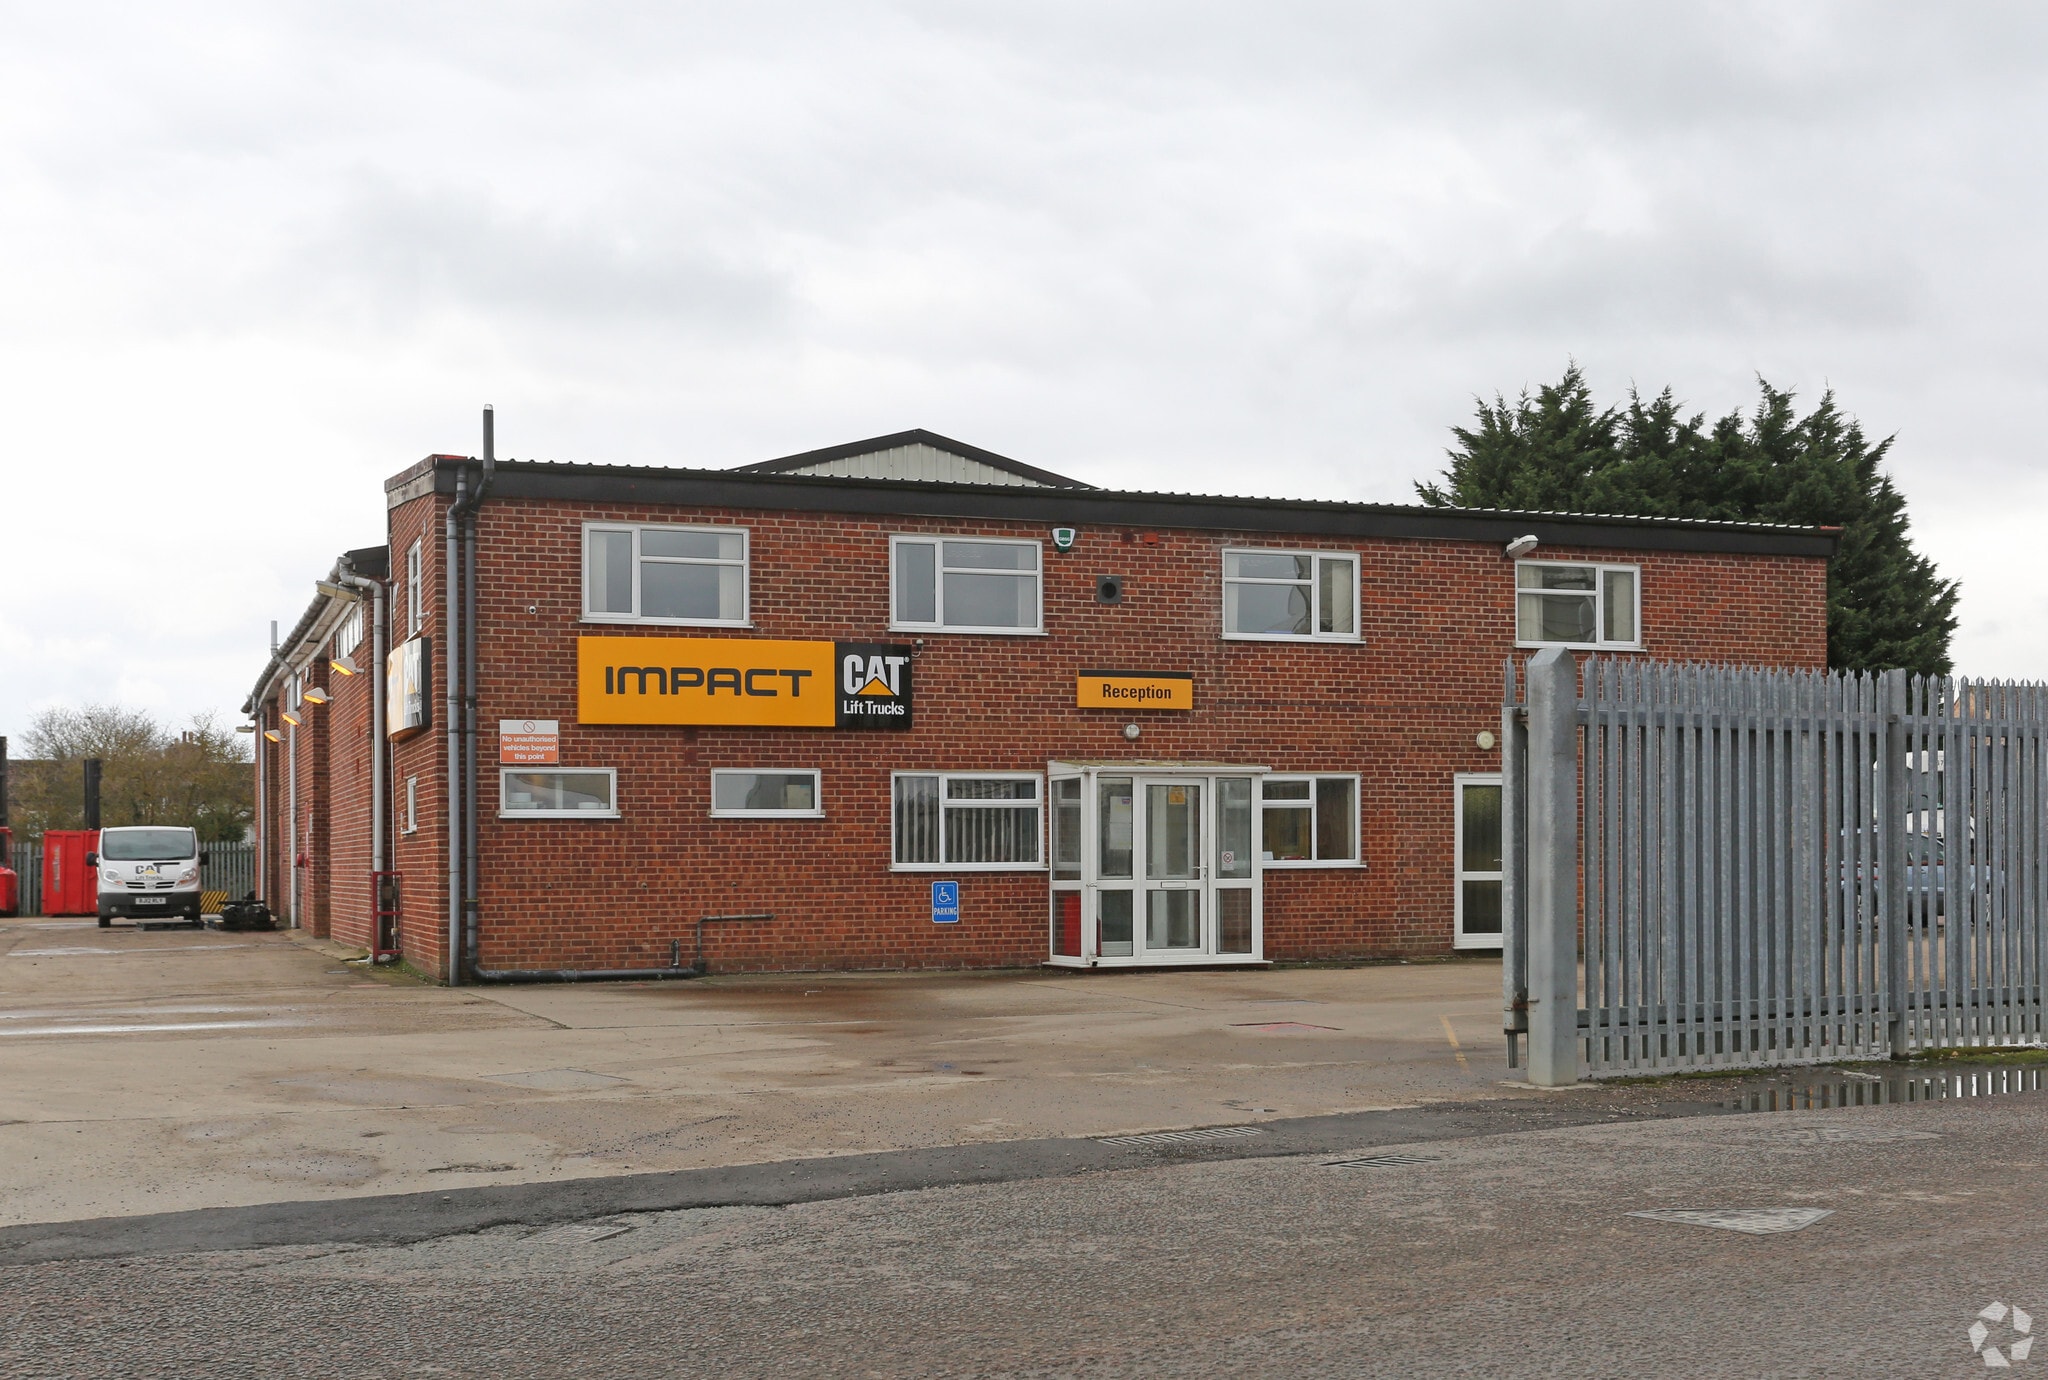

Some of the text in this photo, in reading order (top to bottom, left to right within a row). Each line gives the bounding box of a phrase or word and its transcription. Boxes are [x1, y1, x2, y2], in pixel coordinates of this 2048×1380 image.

[843, 654, 905, 696] CAT
[605, 666, 812, 697] IMPACT
[1102, 683, 1172, 702] Reception
[843, 700, 905, 715] Lift Trucks
[531, 744, 556, 752] beyond
[527, 753, 545, 761] point
[135, 865, 163, 875] CAT
[933, 907, 957, 916] PARKING
